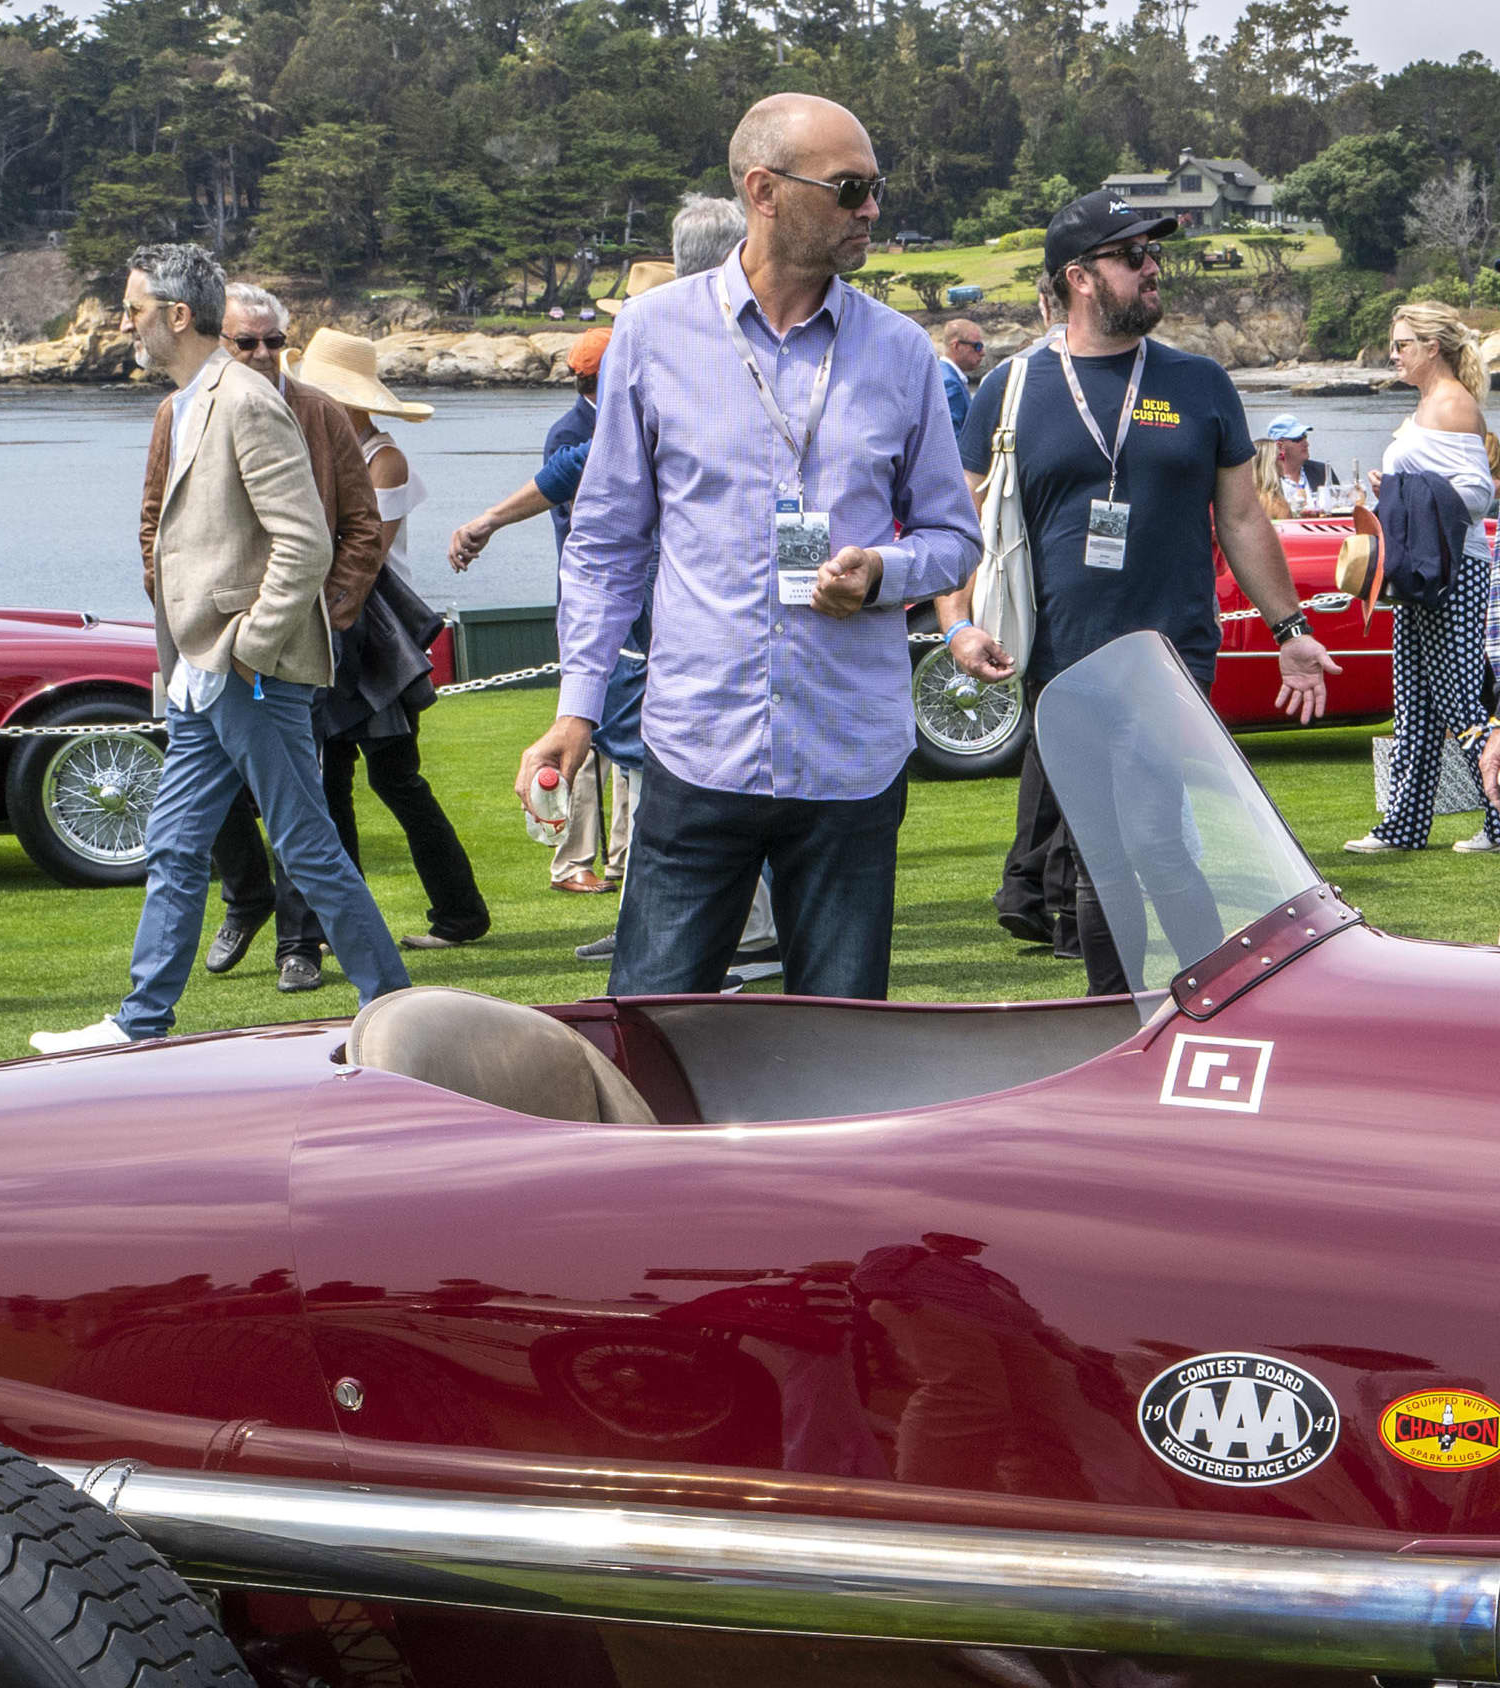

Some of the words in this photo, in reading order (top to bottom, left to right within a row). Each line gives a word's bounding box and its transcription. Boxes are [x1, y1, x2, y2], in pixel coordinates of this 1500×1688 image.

[1142, 398, 1171, 412] DEUS
[1132, 409, 1181, 425] CUSTOMS
[1177, 1359, 1247, 1386] CONTEST
[1255, 1362, 1304, 1393] BOARD
[1144, 1404, 1164, 1422] 19
[1405, 1396, 1459, 1413] EQUIPPED
[1463, 1399, 1489, 1415] WITH
[1178, 1378, 1301, 1460] AAA
[1313, 1415, 1335, 1433] 41
[1396, 1415, 1498, 1447] CHAMPION
[1160, 1436, 1243, 1479] REGISTERED
[1247, 1459, 1286, 1479] RACE
[1286, 1446, 1317, 1470] CAR
[1410, 1447, 1442, 1462] SPARK
[1447, 1450, 1482, 1462] PLUGS
